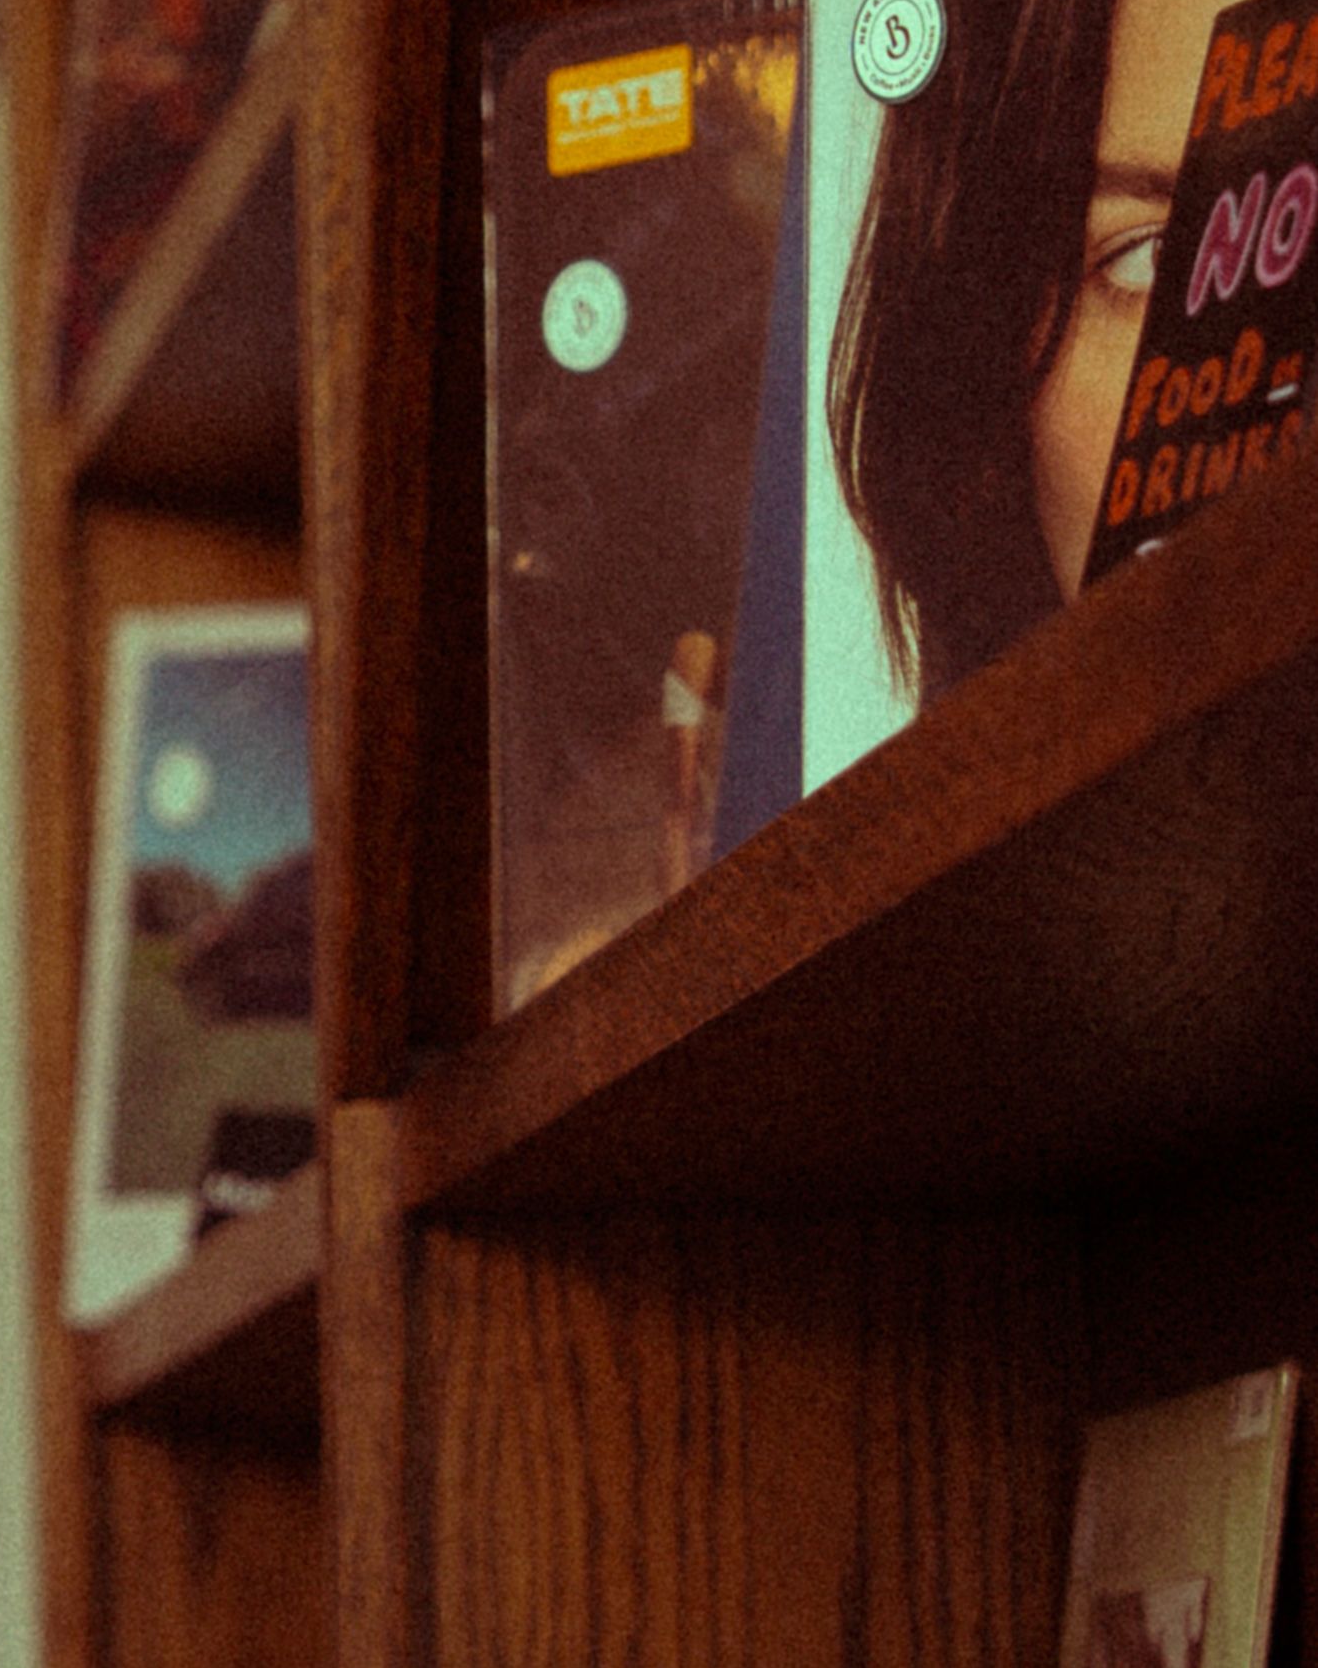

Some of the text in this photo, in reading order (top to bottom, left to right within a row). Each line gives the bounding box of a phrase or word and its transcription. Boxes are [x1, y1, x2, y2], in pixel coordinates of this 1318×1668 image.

[558, 68, 683, 125] TATE
[1186, 164, 1318, 316] NO
[1126, 327, 1265, 441] FOOD
